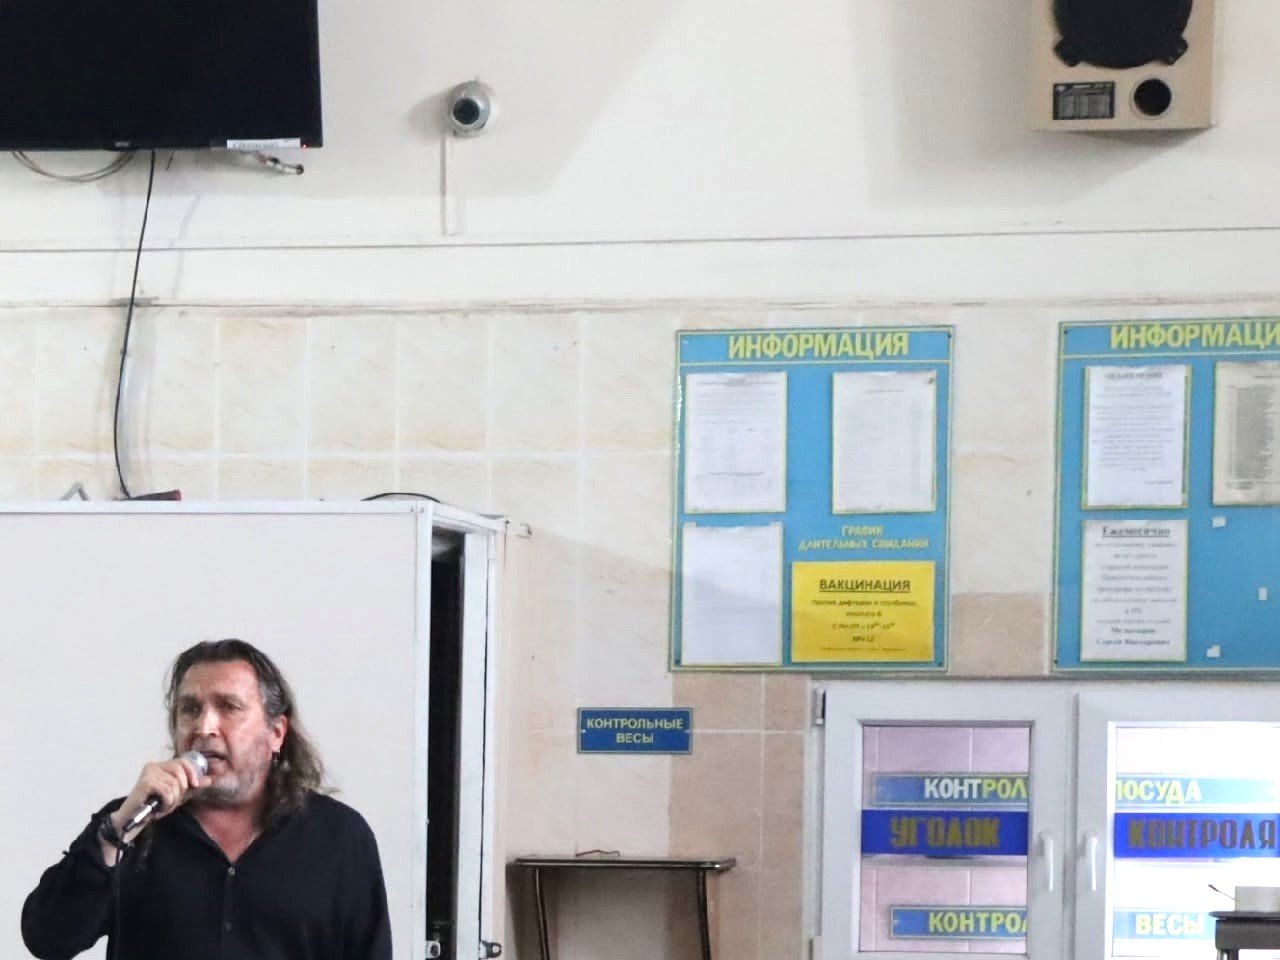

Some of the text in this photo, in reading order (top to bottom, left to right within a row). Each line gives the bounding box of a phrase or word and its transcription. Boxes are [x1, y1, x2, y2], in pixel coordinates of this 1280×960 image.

[728, 332, 909, 359] ИНФОРМАЦИЯ
[1110, 322, 1280, 349] ИНФОРМАЦИ
[841, 525, 883, 536] ГРАФИК
[819, 579, 911, 592] ВАКЦИНАЦИЯ
[586, 718, 684, 729] КОНТРОЛЬНЫЕ
[616, 733, 654, 743] ВЕСЫ
[924, 778, 1027, 799] КОНТРОЛ
[889, 816, 1001, 848] УГОЛОК
[1128, 819, 1276, 850] КОНТРОЛЯ
[928, 911, 1026, 933] КОНТРО
[1135, 913, 1205, 935] ВЕСЫ
